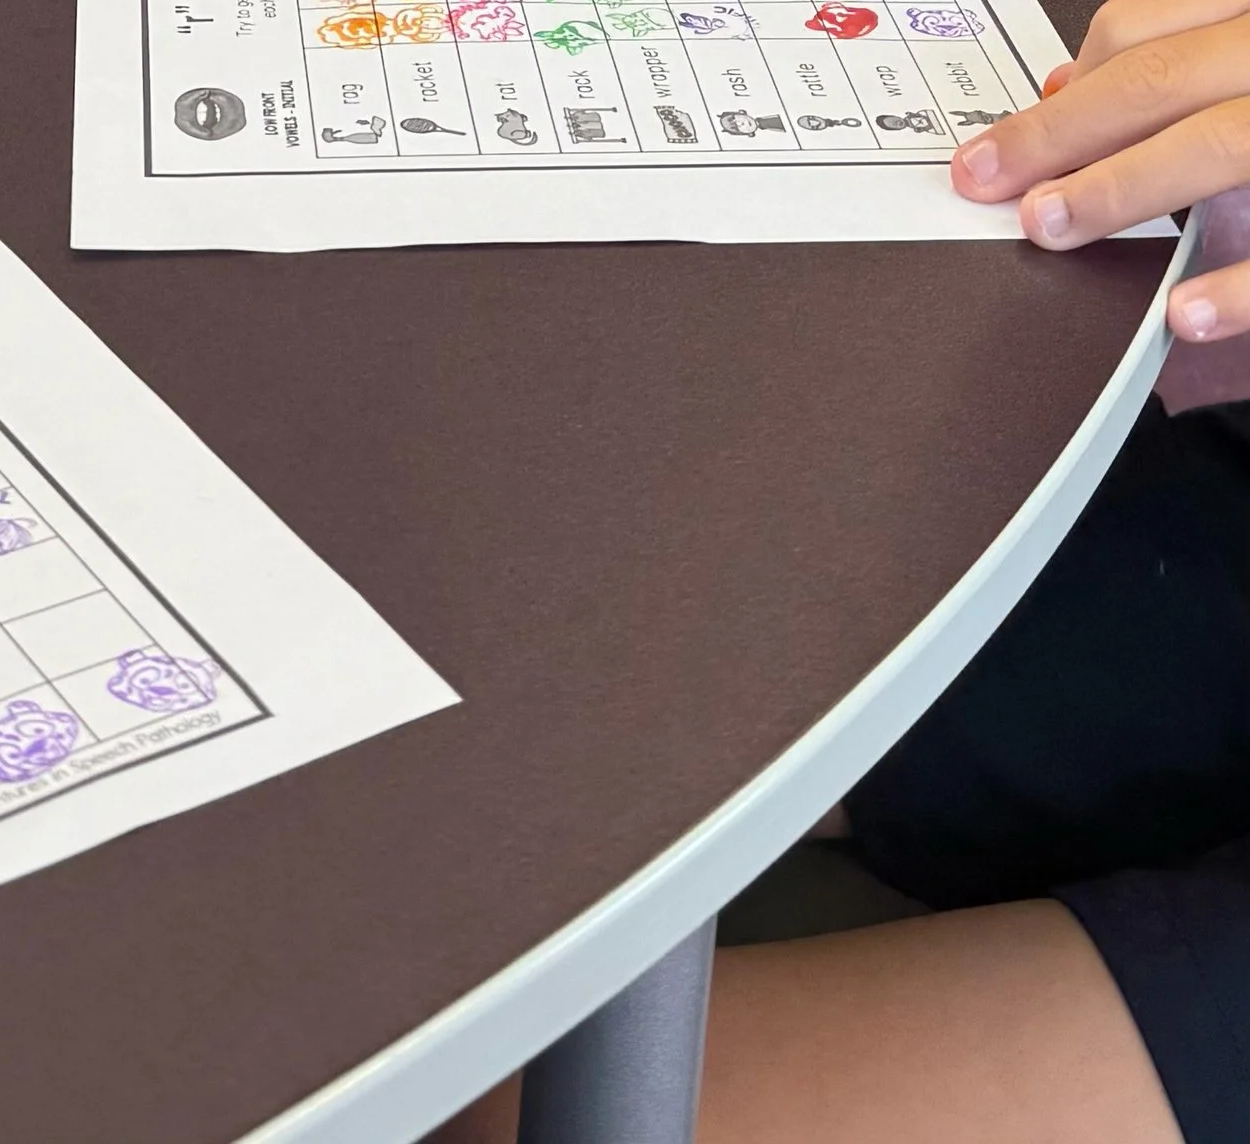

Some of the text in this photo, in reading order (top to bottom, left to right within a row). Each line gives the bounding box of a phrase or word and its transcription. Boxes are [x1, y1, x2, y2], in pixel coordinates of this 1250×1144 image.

[236, 21, 254, 37] Try
[412, 61, 439, 103] racket
[568, 69, 596, 100] rack
[640, 46, 672, 99] wrapper
[721, 68, 751, 98] rash
[796, 62, 828, 98] rattle
[875, 65, 903, 98] wrap
[946, 61, 980, 97] rabbit
[280, 80, 296, 108] INITIAL
[342, 83, 364, 105] rag
[497, 82, 517, 101] rat
[261, 92, 278, 135] LOW FRONT
[283, 116, 300, 148] VOWELS
[52, 766, 71, 785] in
[69, 741, 137, 777] Speech
[135, 708, 223, 749] Pathology
